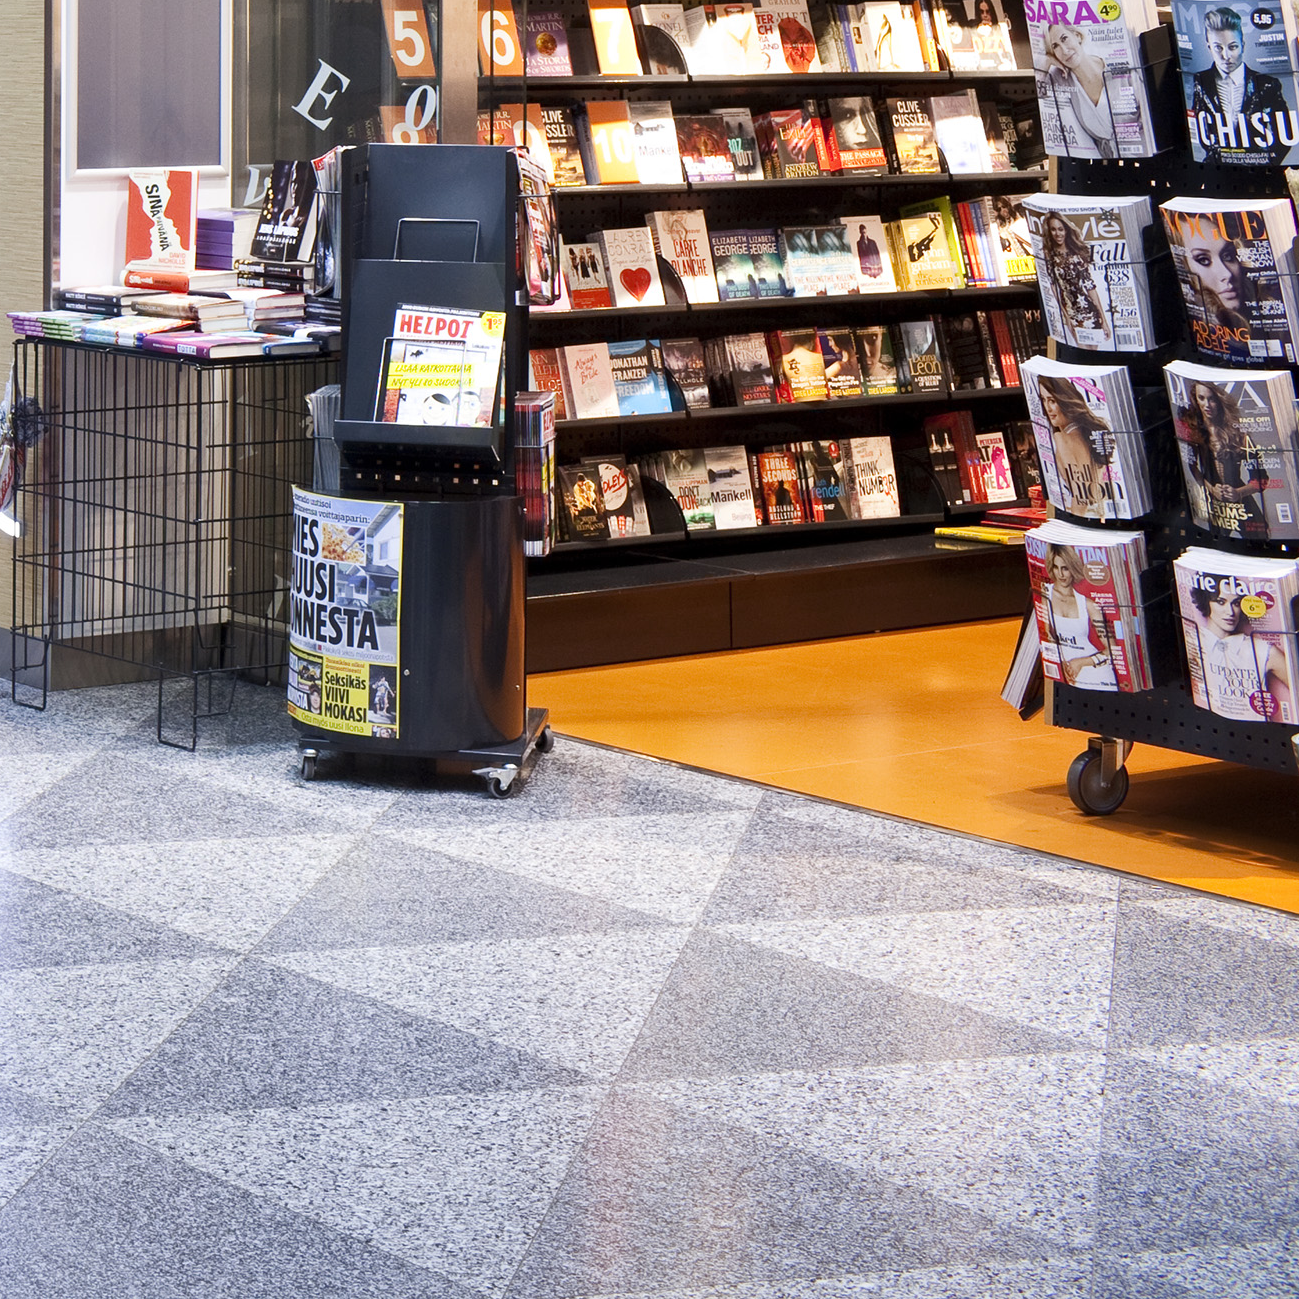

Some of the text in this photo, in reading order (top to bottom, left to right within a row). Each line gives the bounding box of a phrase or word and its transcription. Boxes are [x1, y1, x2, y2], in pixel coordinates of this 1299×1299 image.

[1253, 14, 1272, 25] 5,95
[393, 11, 426, 67] 5
[481, 11, 515, 66] 6
[594, 9, 625, 65] 7
[1259, 33, 1285, 42] JUSTIN
[537, 55, 569, 66] STORM
[897, 101, 921, 113] CLIVE
[892, 114, 929, 127] CUSSLER
[545, 125, 575, 138] SSLER
[1198, 110, 1299, 148] CHISU
[595, 128, 635, 164] 10
[785, 163, 818, 173] ANDREW
[786, 171, 819, 179] BRITTON
[145, 184, 163, 218] SINÄ
[1160, 207, 1268, 242] VOGUE
[156, 217, 172, 252] PÄIVÄNÄ
[607, 230, 650, 244] LAUREN
[712, 235, 747, 245] ELIZABETH
[608, 242, 653, 257] CONRAD
[674, 239, 700, 258] CARTE
[715, 244, 749, 257] GEORGE
[1089, 243, 1127, 262] Fall
[1237, 253, 1273, 262] WOMAN
[1251, 260, 1274, 268] NOW
[911, 259, 950, 274] grisham
[916, 275, 954, 287] confession
[1104, 270, 1130, 283] 638
[1120, 309, 1138, 318] 156
[399, 314, 474, 339] HELPOT
[177, 345, 196, 354] TOTTA
[735, 350, 763, 362] KING
[609, 356, 648, 370] JONATHAN
[912, 353, 936, 363] Donna
[1246, 355, 1264, 364] global
[909, 358, 942, 376] Leon
[613, 369, 647, 381] FRANZEN
[615, 383, 655, 397] FREEDOM
[765, 457, 789, 469] THREE
[855, 460, 878, 479] THINK
[763, 469, 796, 483] SECONDS
[1065, 463, 1093, 482] Fall
[711, 489, 752, 503] Mankell
[812, 483, 845, 499] rendell
[318, 510, 371, 524] voittajaparin:
[1176, 569, 1277, 596] marie claire
[1209, 663, 1256, 680] UPDATE
[325, 671, 367, 690] Seksikäs
[1225, 676, 1262, 690] YOUR
[325, 686, 350, 705] VIIVI
[1219, 685, 1250, 698] LOOK
[325, 702, 367, 724] MOKASI
